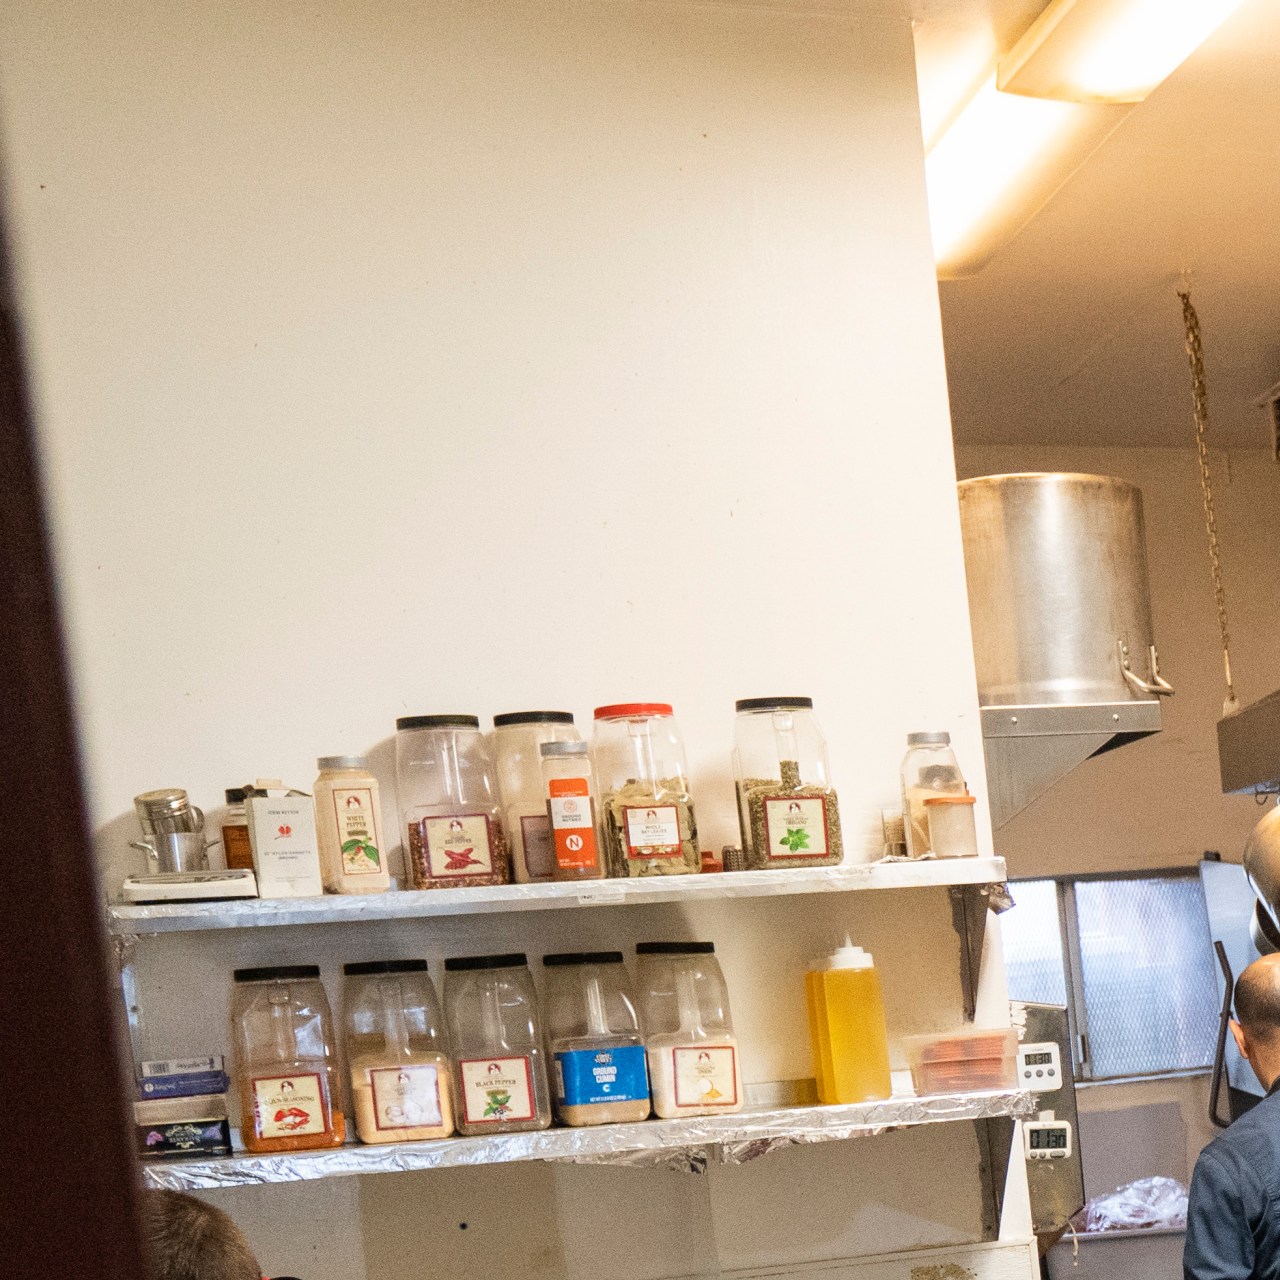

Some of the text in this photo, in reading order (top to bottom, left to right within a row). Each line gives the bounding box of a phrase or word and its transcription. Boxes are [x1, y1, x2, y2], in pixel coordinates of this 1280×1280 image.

[569, 837, 580, 848] N
[592, 1066, 618, 1076] GROUND
[595, 1075, 616, 1083] CUMIN
[602, 1083, 610, 1092] C
